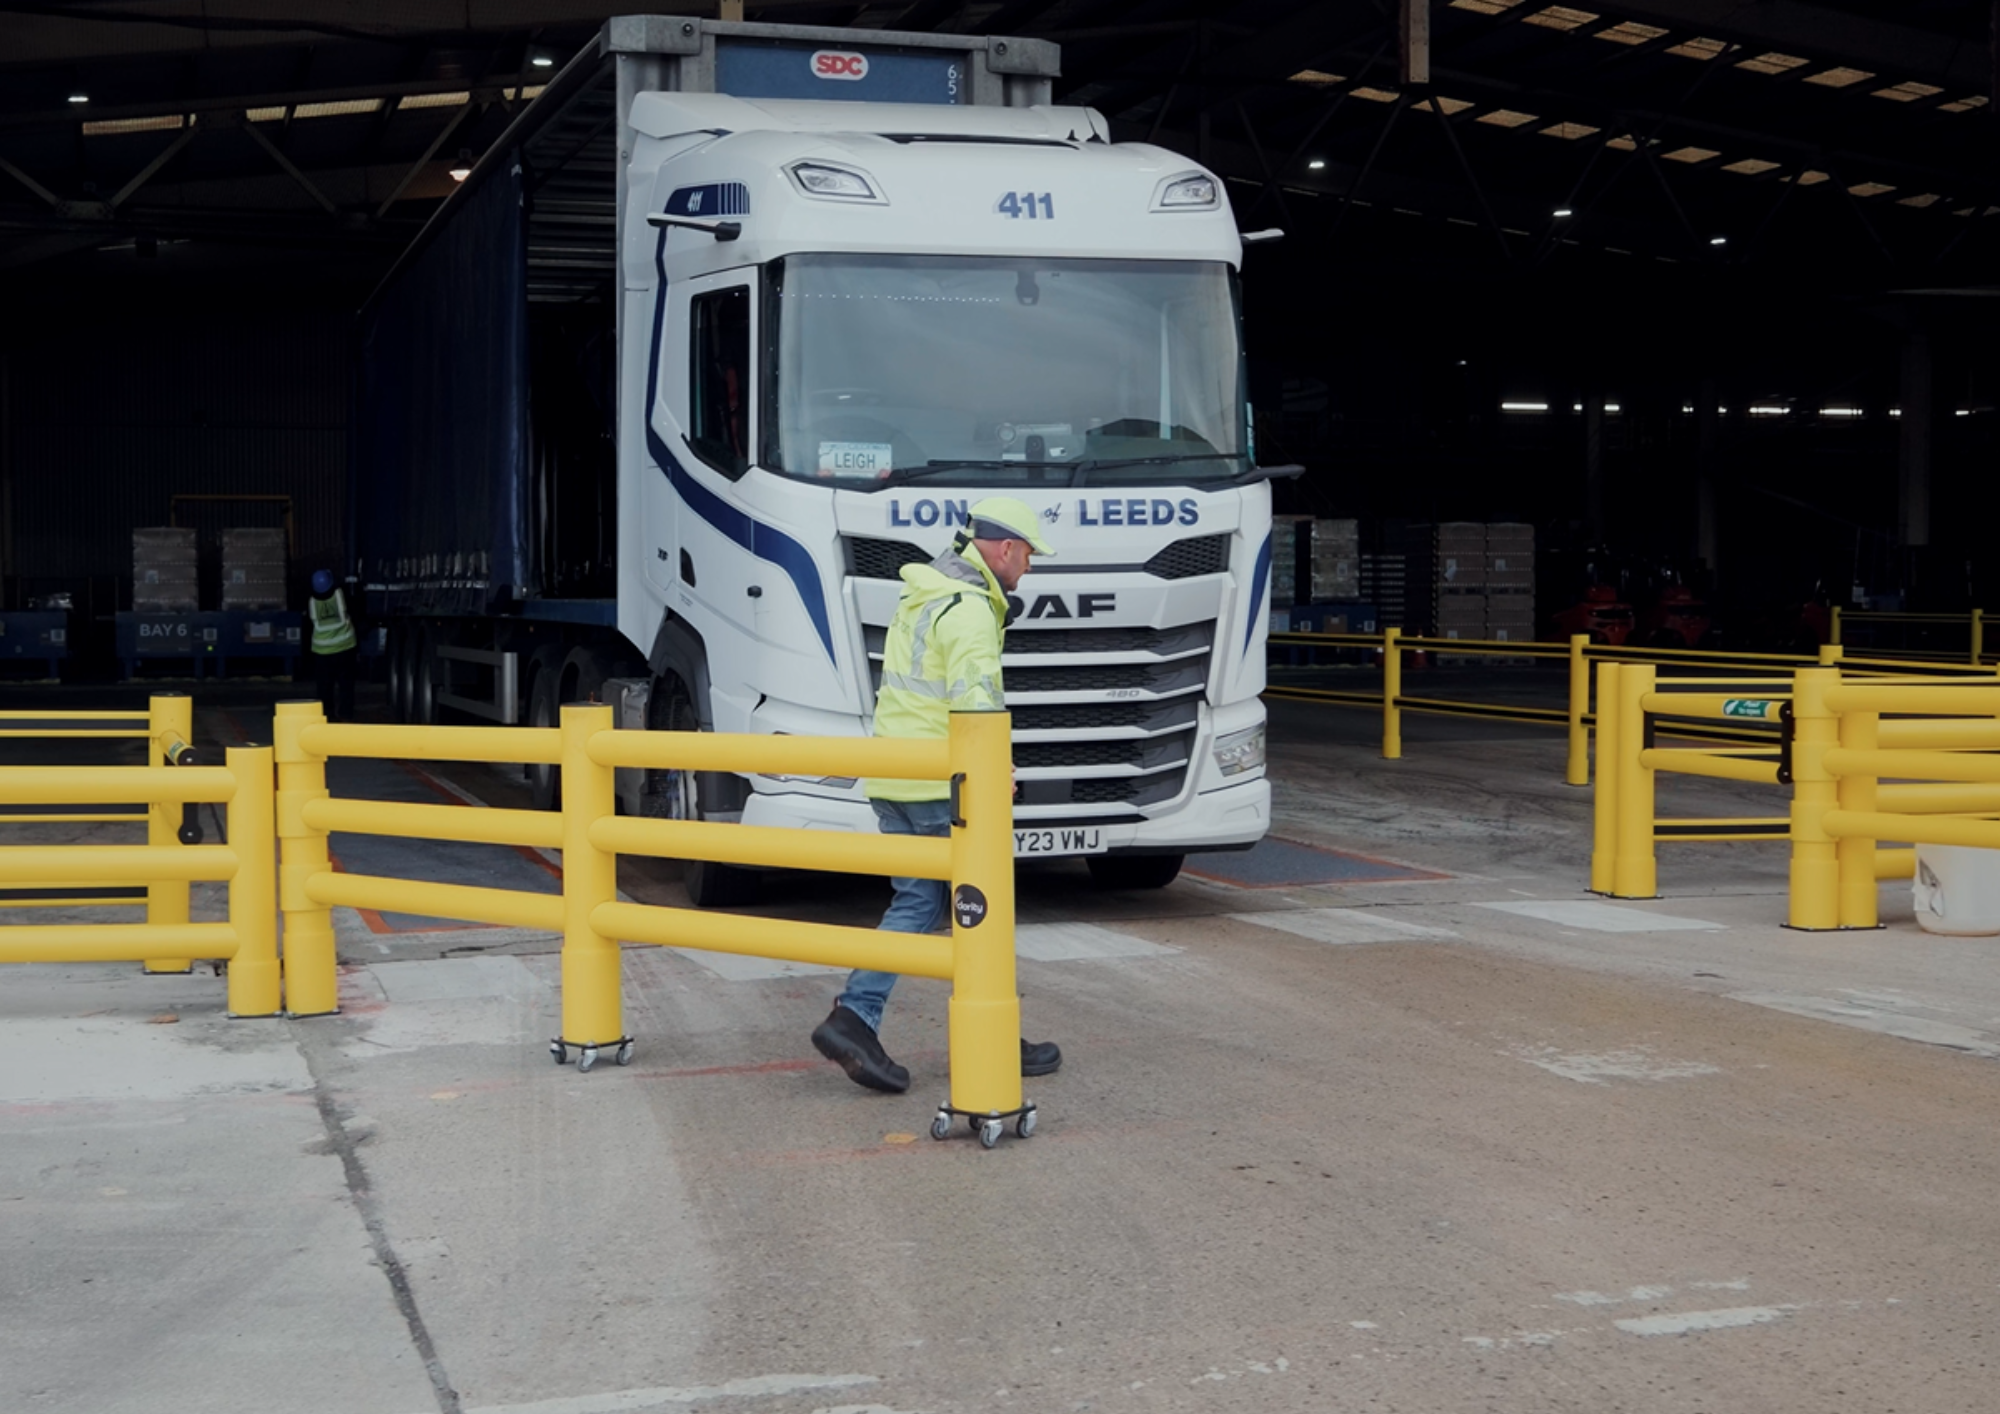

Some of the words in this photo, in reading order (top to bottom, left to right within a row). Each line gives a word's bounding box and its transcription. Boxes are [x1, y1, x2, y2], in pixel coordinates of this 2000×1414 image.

[816, 54, 863, 76] SDC
[997, 191, 1055, 219] 411
[834, 452, 876, 469] LEIGH
[890, 499, 968, 527] LON
[1043, 502, 1062, 523] of
[1078, 498, 1200, 526] LEEDS
[139, 623, 173, 637] BAY
[177, 623, 188, 637] 6
[1105, 690, 1140, 698] 480
[1013, 831, 1054, 852] Y23
[1060, 829, 1099, 850] VWJ
